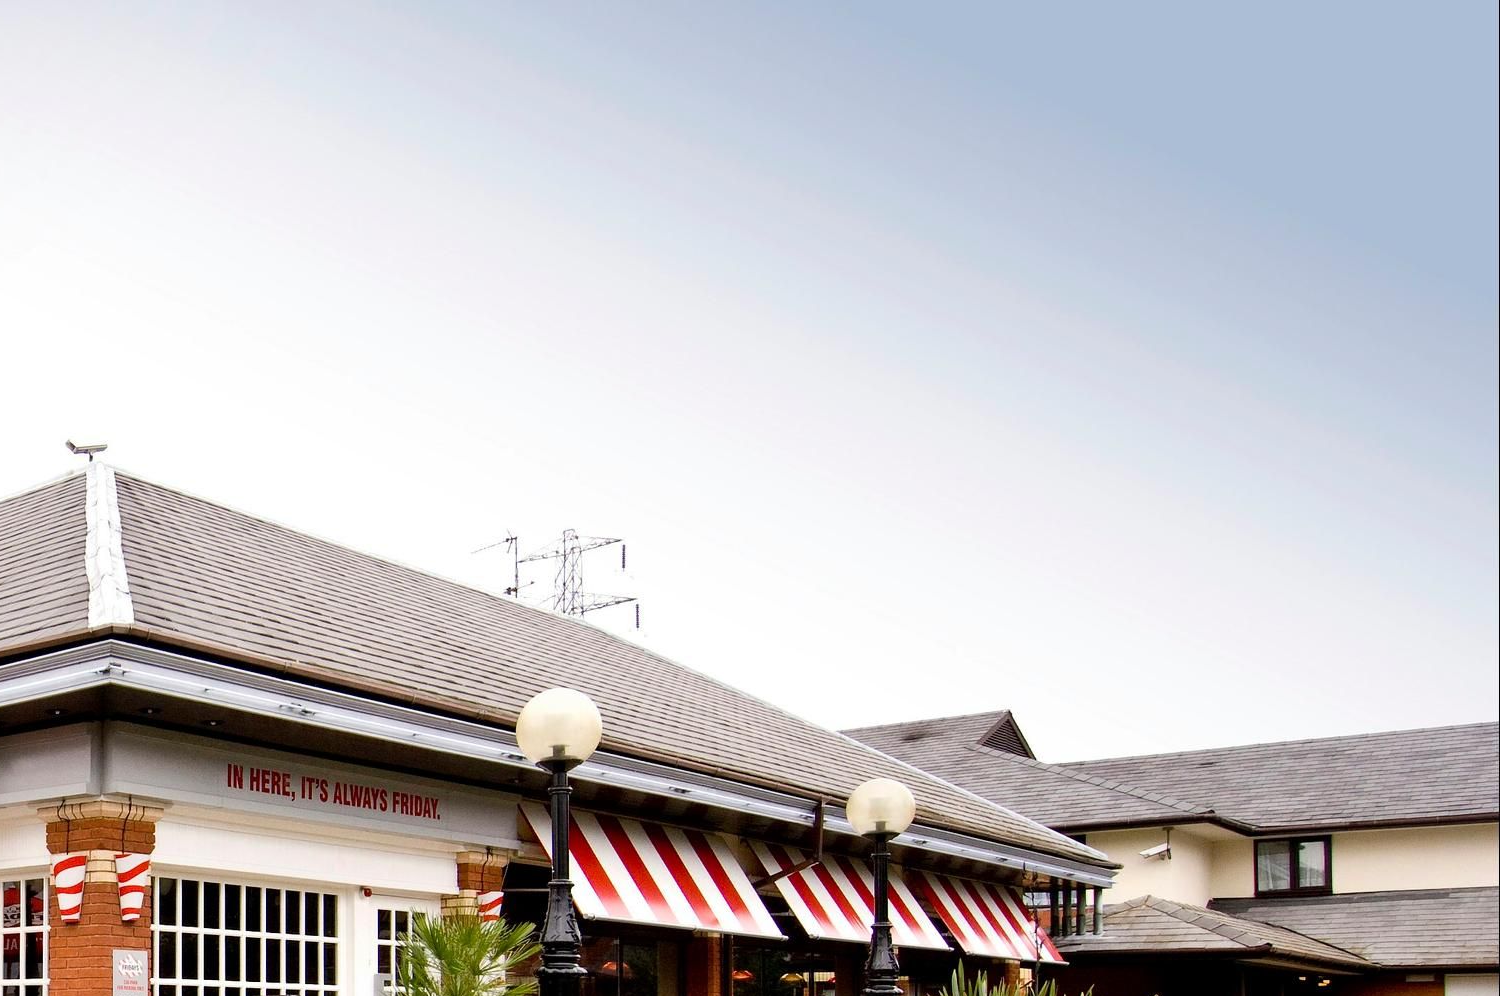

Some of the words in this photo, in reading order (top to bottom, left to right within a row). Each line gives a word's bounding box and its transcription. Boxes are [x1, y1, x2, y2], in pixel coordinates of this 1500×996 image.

[227, 763, 244, 789] IN
[250, 768, 296, 801] HERE,
[301, 776, 328, 803] IT'S
[333, 782, 388, 812] ALWAYS
[392, 791, 441, 820] FRIDAY.
